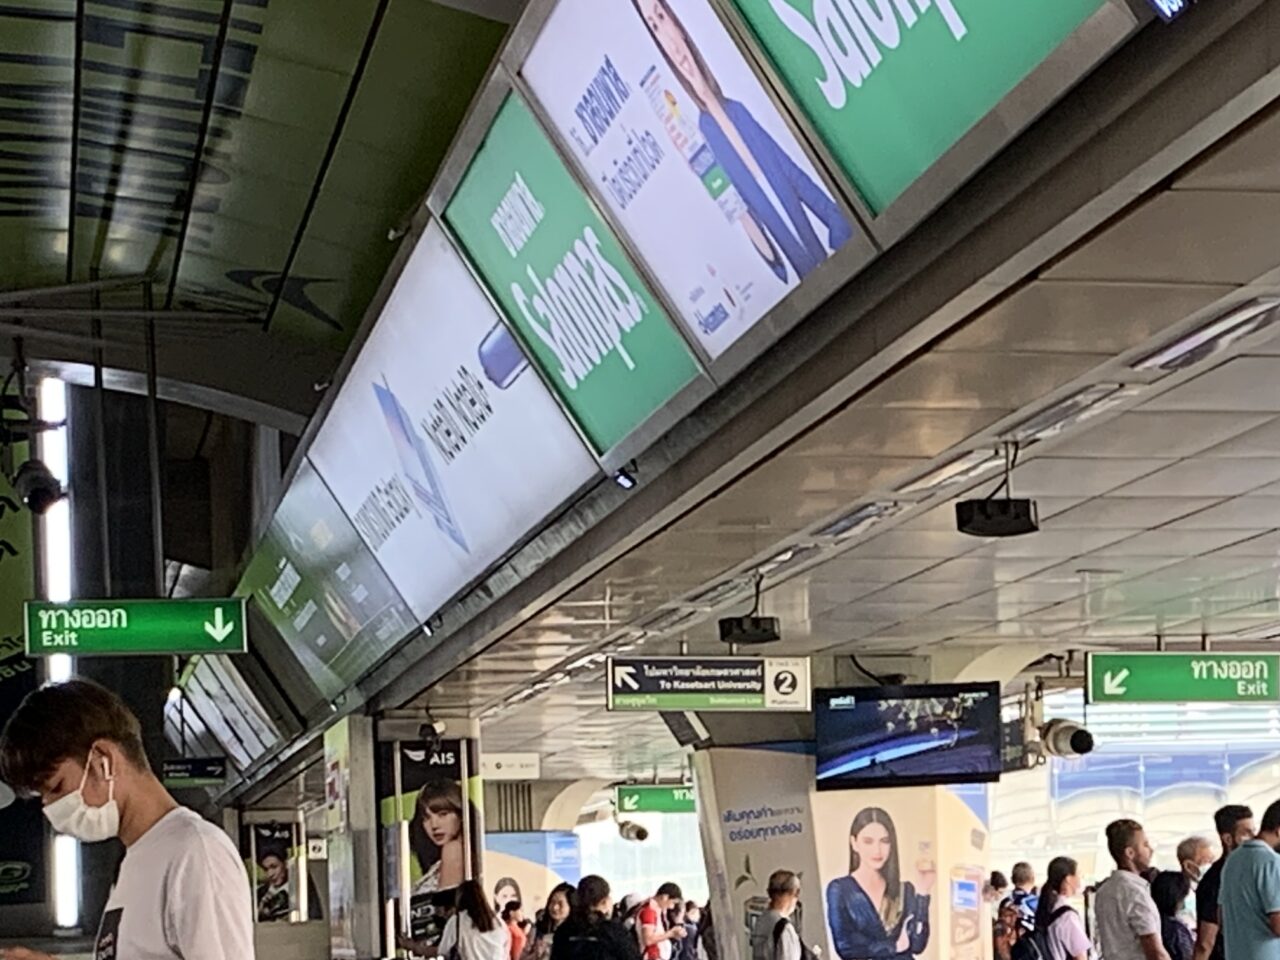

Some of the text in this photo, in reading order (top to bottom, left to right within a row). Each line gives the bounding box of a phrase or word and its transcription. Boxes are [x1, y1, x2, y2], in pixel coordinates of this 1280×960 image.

[511, 226, 643, 390] Salonpas
[38, 608, 128, 629] ทางออก
[42, 631, 78, 646] Exit
[1191, 660, 1268, 679] ทางออก
[659, 680, 672, 690] To
[717, 680, 762, 691] University
[1237, 681, 1268, 696] Exit
[429, 752, 456, 765] AIS
[672, 788, 694, 801] ทาง
